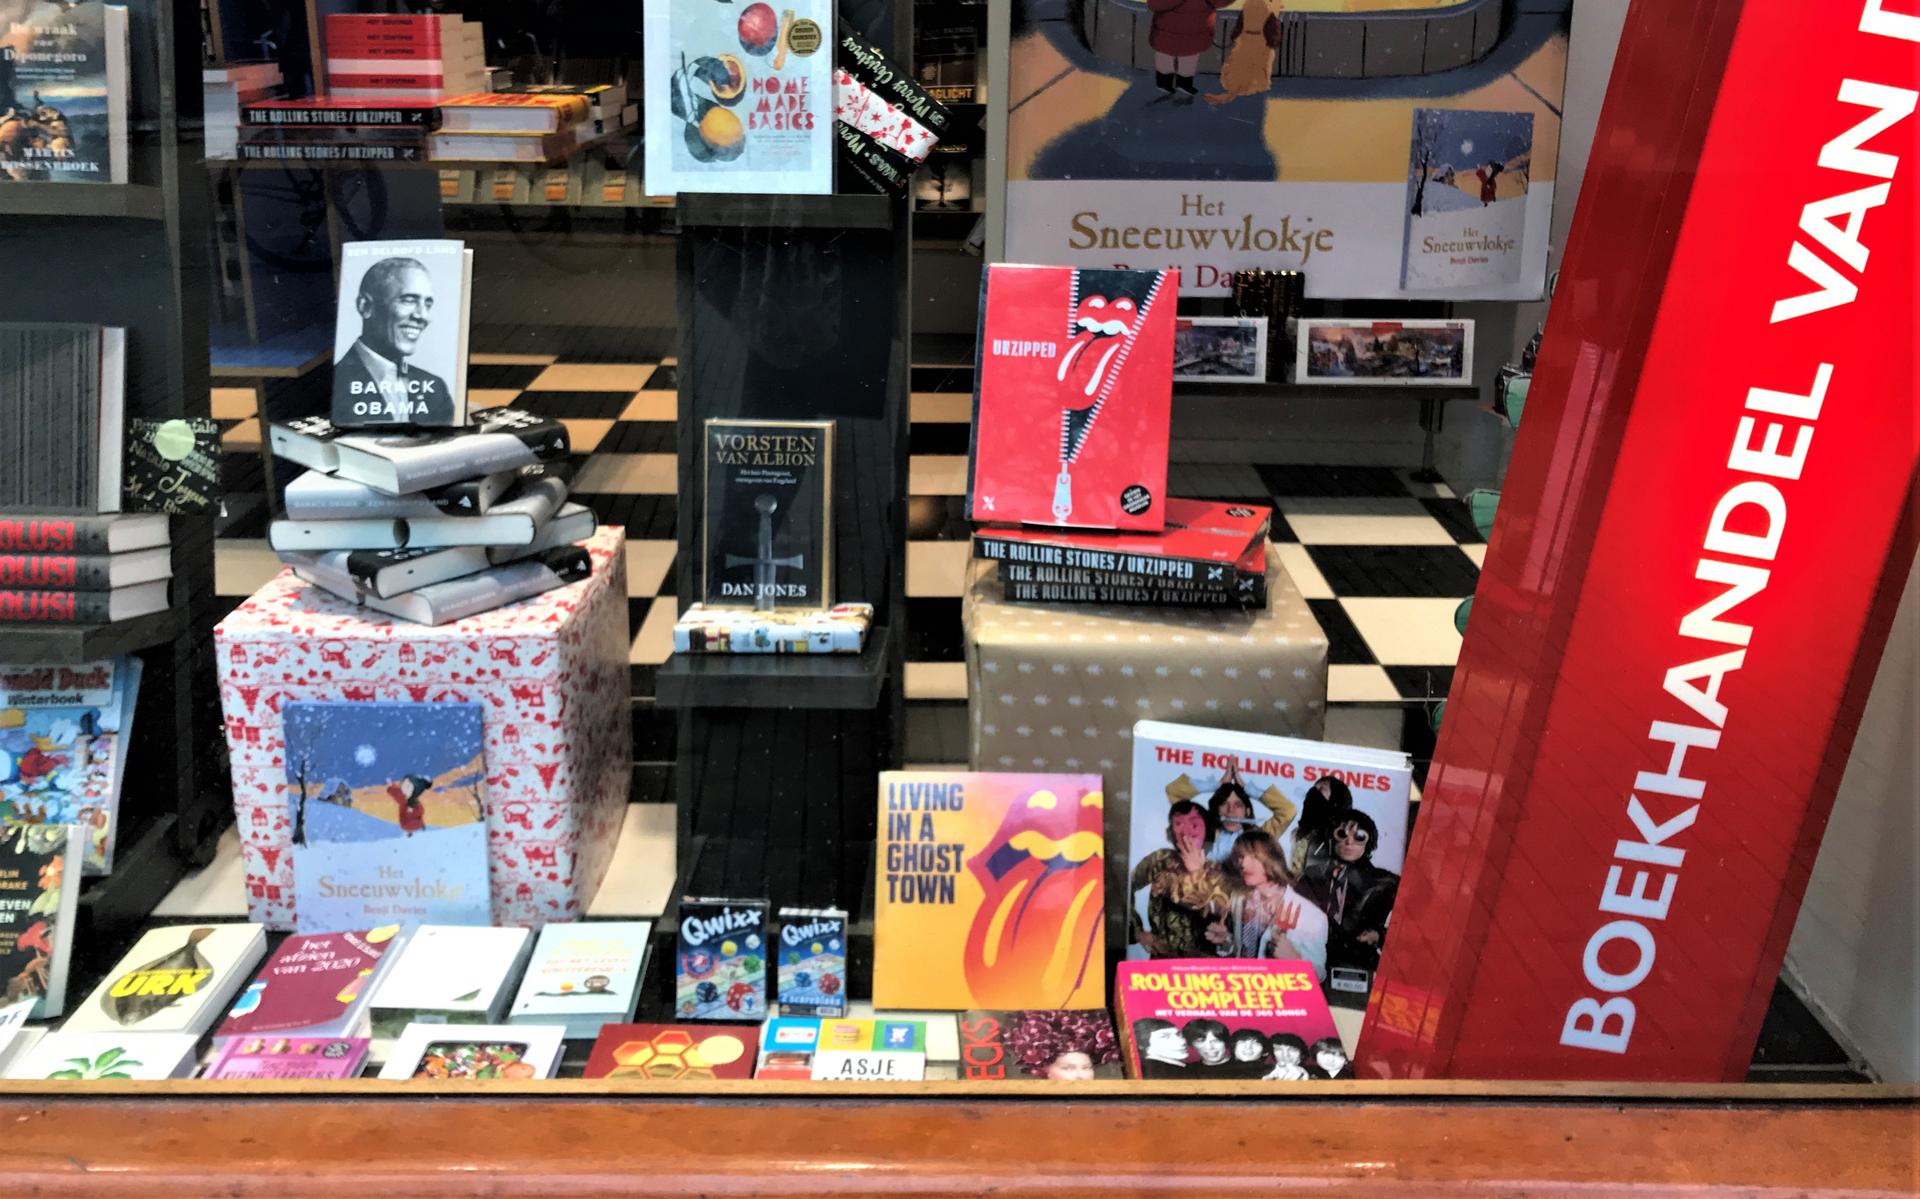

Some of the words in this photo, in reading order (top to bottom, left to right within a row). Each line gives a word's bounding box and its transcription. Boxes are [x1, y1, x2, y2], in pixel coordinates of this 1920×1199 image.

[842, 37, 894, 85] Christmas
[752, 76, 810, 94] HOME
[756, 94, 808, 113] MADE
[249, 108, 268, 123] THE
[269, 108, 309, 123] ROLLING
[310, 108, 348, 123] STONES
[355, 107, 402, 123] UNZIPPED
[748, 112, 815, 131] BASICS
[244, 145, 262, 159] THE
[264, 145, 303, 159] ROLLING
[304, 145, 340, 159] STONES
[1180, 194, 1225, 217] Het
[1068, 210, 1334, 265] Sneeuwvlokje
[1422, 235, 1515, 254] Sneeuwvlokje
[992, 339, 1057, 358] UNZIPPED
[350, 380, 436, 395] BARACK
[353, 400, 430, 416] OBAMA
[714, 433, 817, 453] VORSTEN
[716, 452, 749, 465] VAN
[752, 453, 816, 466] ALBION
[983, 541, 1006, 559] THE
[1010, 543, 1062, 565] ROLLING
[1066, 549, 1116, 571] STONES
[1127, 556, 1194, 580] UNZIPPED
[1559, 362, 1833, 1055] BOEKHANDEL
[1772, 77, 1919, 326] VAN
[1008, 564, 1033, 582] THE
[1036, 566, 1091, 585] ROLLING
[721, 583, 755, 596] DAN
[755, 584, 807, 600] JONES
[1015, 583, 1038, 600] THE
[1042, 585, 1095, 602] ROLLING
[8, 693, 84, 706] Winterbook
[1154, 746, 1194, 766] THE
[1201, 752, 1295, 780] ROLLING
[1303, 765, 1391, 793] STONES
[888, 782, 964, 811] LIVING
[888, 812, 911, 842] IN
[919, 812, 935, 842] A
[887, 843, 964, 873] GHOST
[378, 865, 404, 879] Het
[887, 874, 956, 904] TOWN
[0, 899, 32, 910] EVEN
[0, 912, 15, 924] EN
[681, 906, 762, 947] Qwixx
[781, 918, 841, 947] Qwixx
[300, 938, 332, 951] het
[273, 964, 307, 976] van
[310, 956, 361, 974] 2020
[109, 967, 212, 998] URK
[1130, 972, 1224, 992] ROLLING
[1226, 973, 1313, 992] STONES
[1167, 991, 1284, 1010] COMPLEET
[1155, 1008, 1174, 1017] HET
[1175, 1008, 1217, 1017] VERHAAL
[1219, 1008, 1239, 1017] VAN
[1240, 1008, 1254, 1017] DE
[1275, 1008, 1308, 1017] SONGS
[840, 1058, 896, 1077] ASJE
